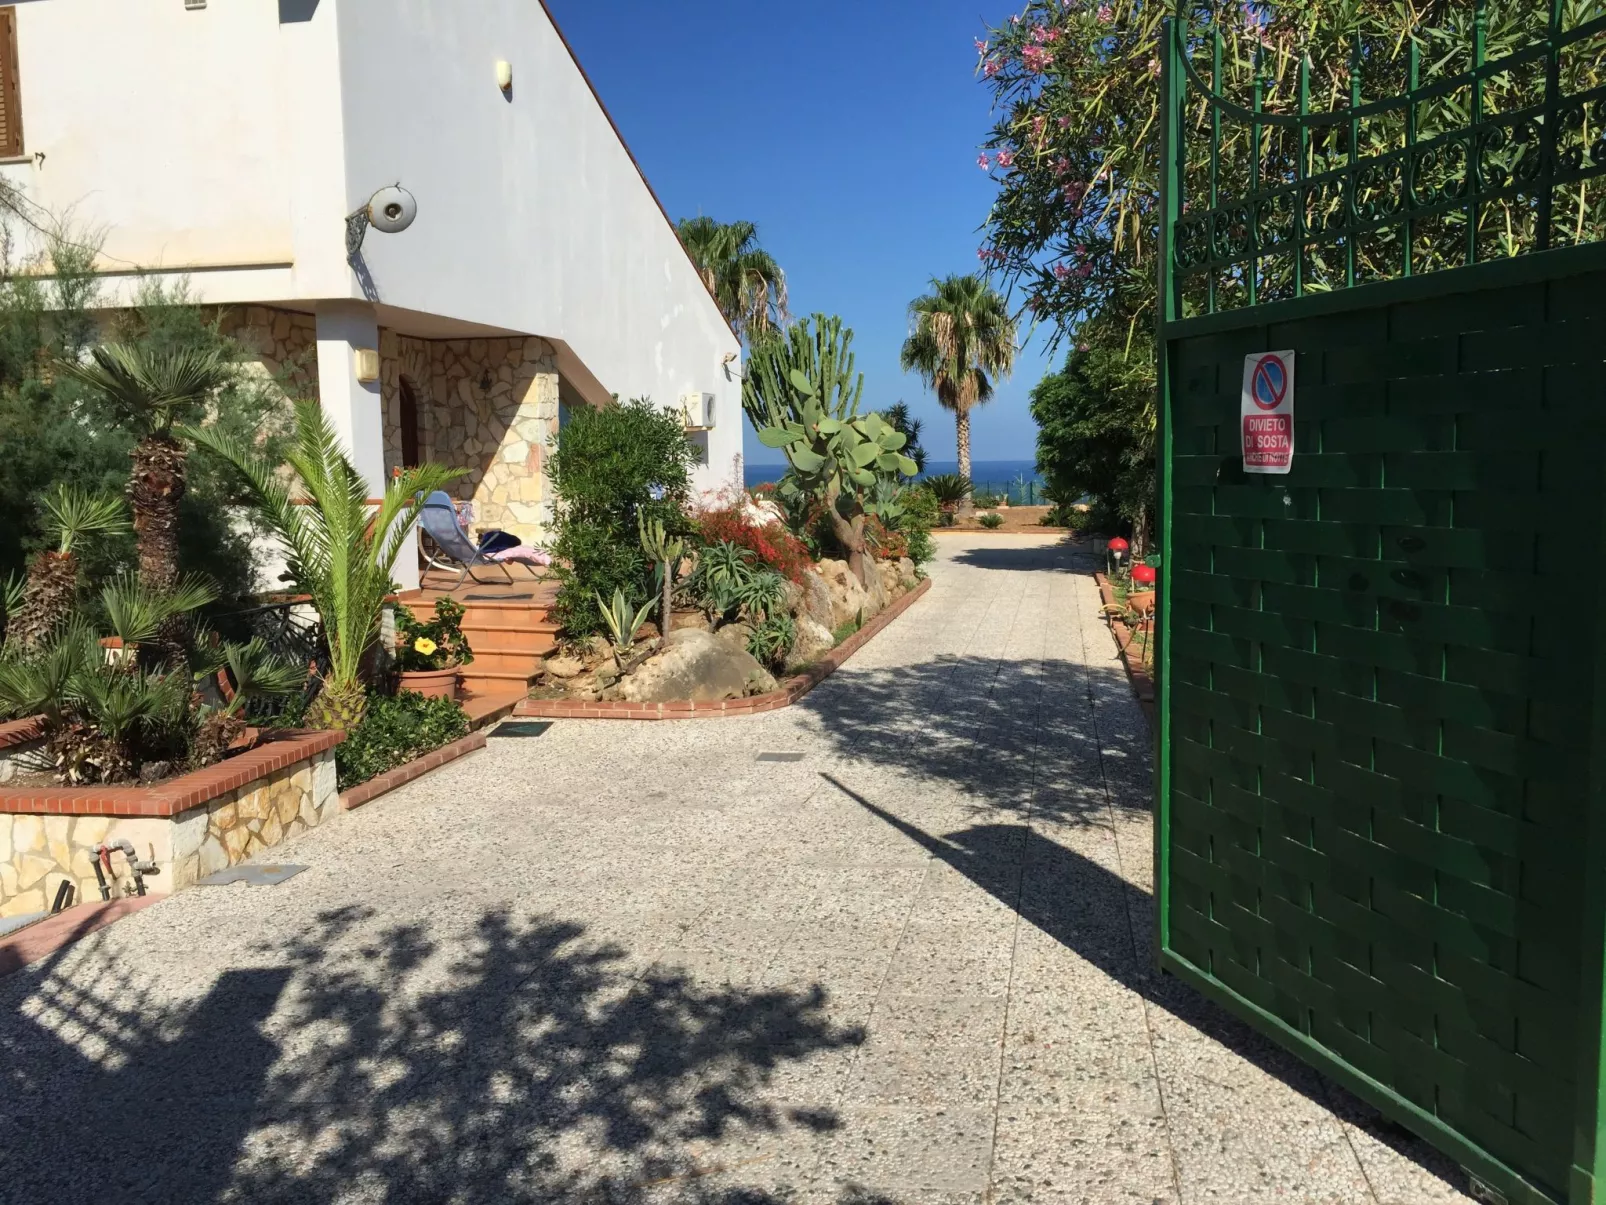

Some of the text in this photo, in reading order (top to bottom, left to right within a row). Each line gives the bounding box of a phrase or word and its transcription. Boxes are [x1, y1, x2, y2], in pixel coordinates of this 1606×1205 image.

[1249, 418, 1286, 431] DIVIETO
[1245, 435, 1289, 448] DI SOSTA
